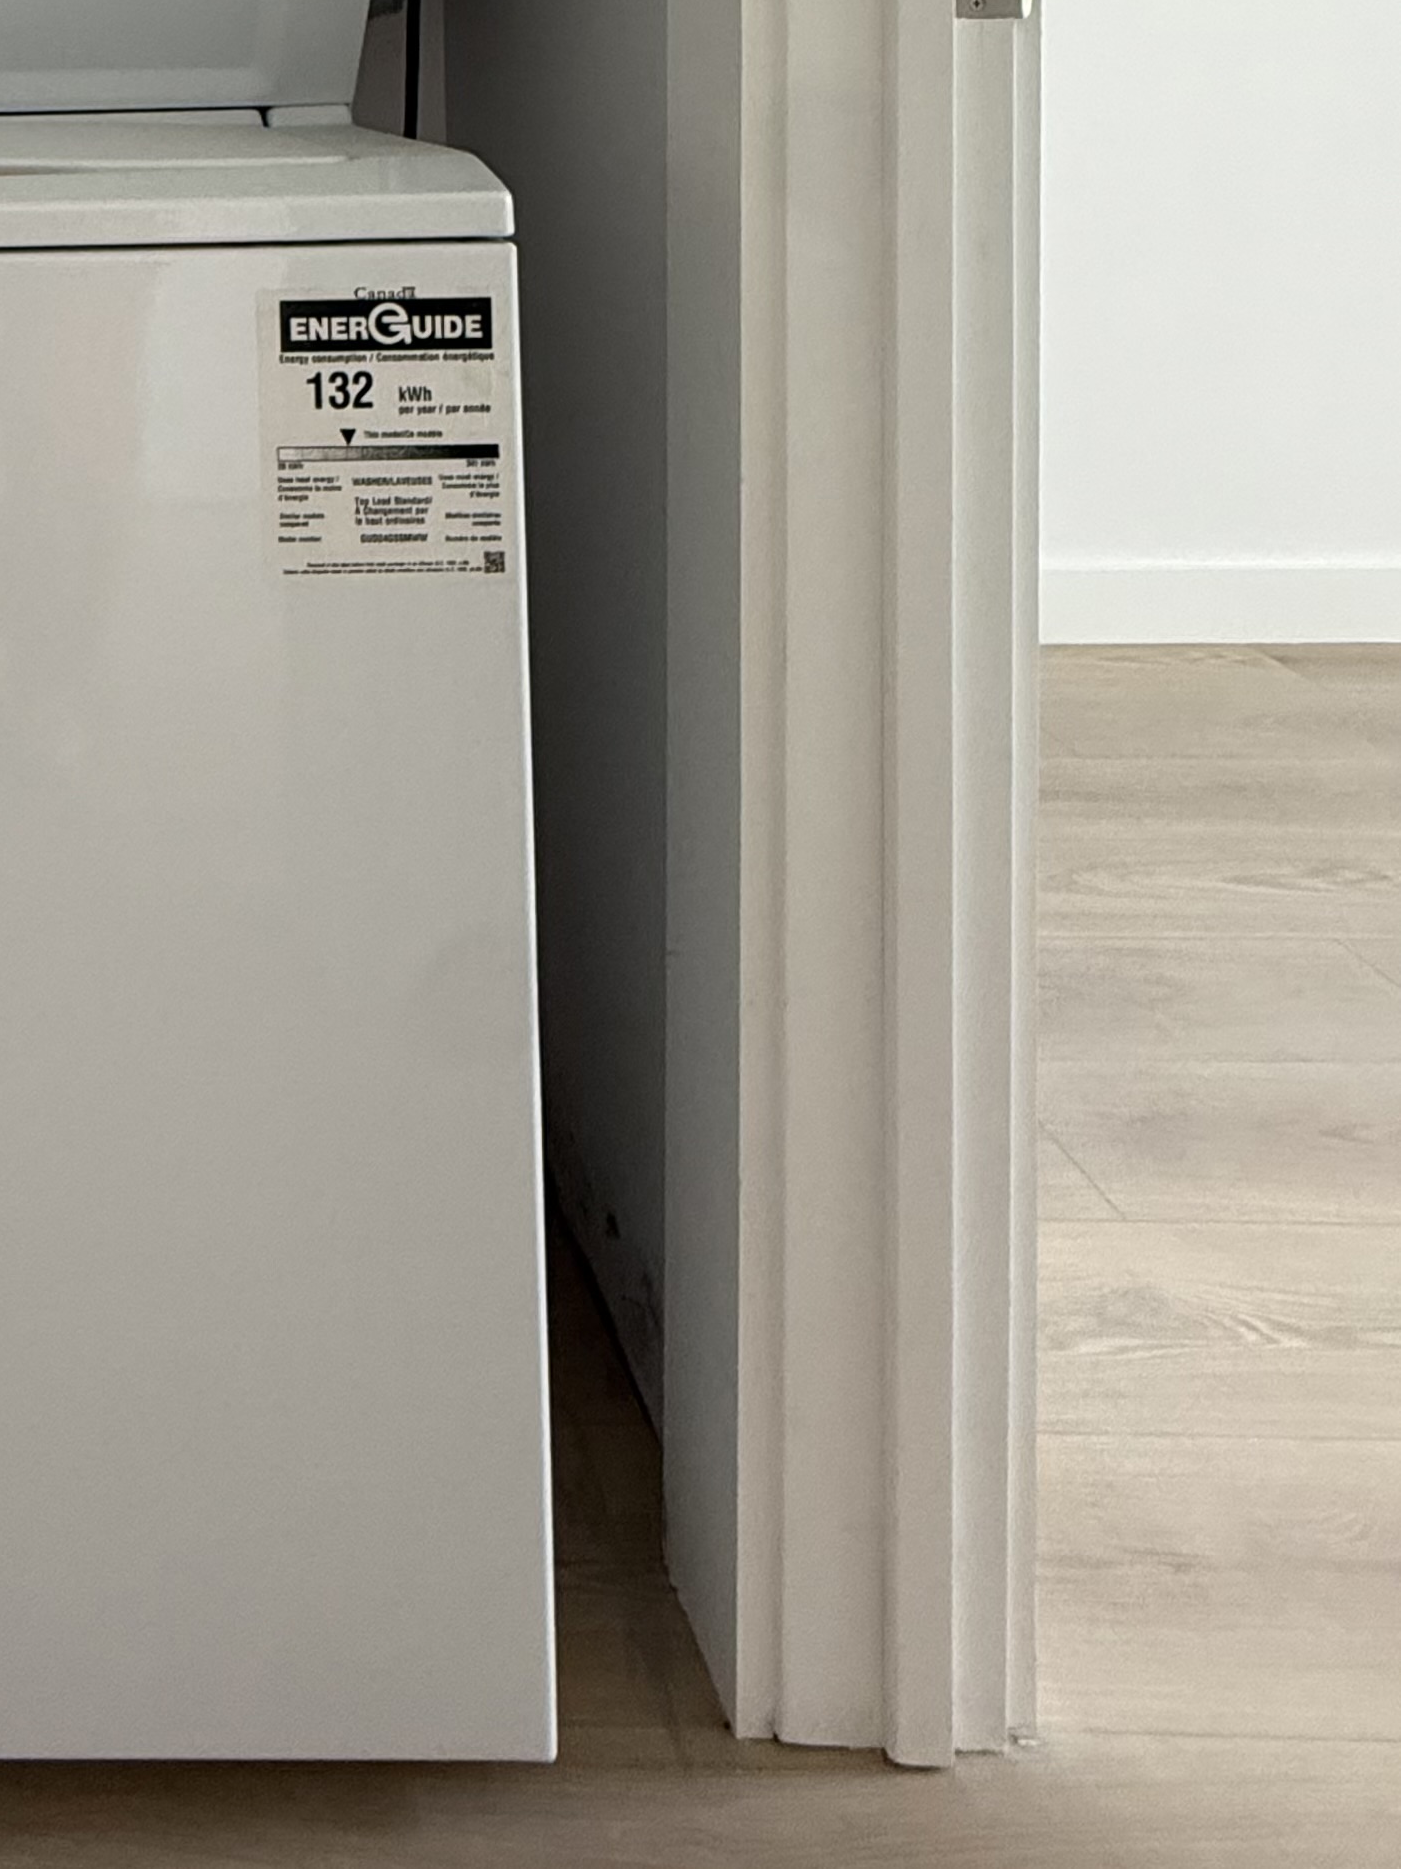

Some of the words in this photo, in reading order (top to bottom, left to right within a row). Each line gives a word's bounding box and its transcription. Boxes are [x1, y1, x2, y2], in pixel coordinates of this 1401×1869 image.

[289, 302, 483, 345] ENERGUIDE
[279, 353, 309, 366] Energy
[311, 354, 368, 365] consumption
[375, 352, 440, 363] Consommation
[442, 351, 495, 362] énergétique
[306, 370, 374, 410] 132
[398, 386, 432, 402] kWh
[398, 406, 414, 415] per
[416, 406, 437, 415] year
[445, 405, 461, 415] par
[462, 403, 491, 413] année
[355, 496, 370, 507] Top
[371, 495, 391, 506] Load
